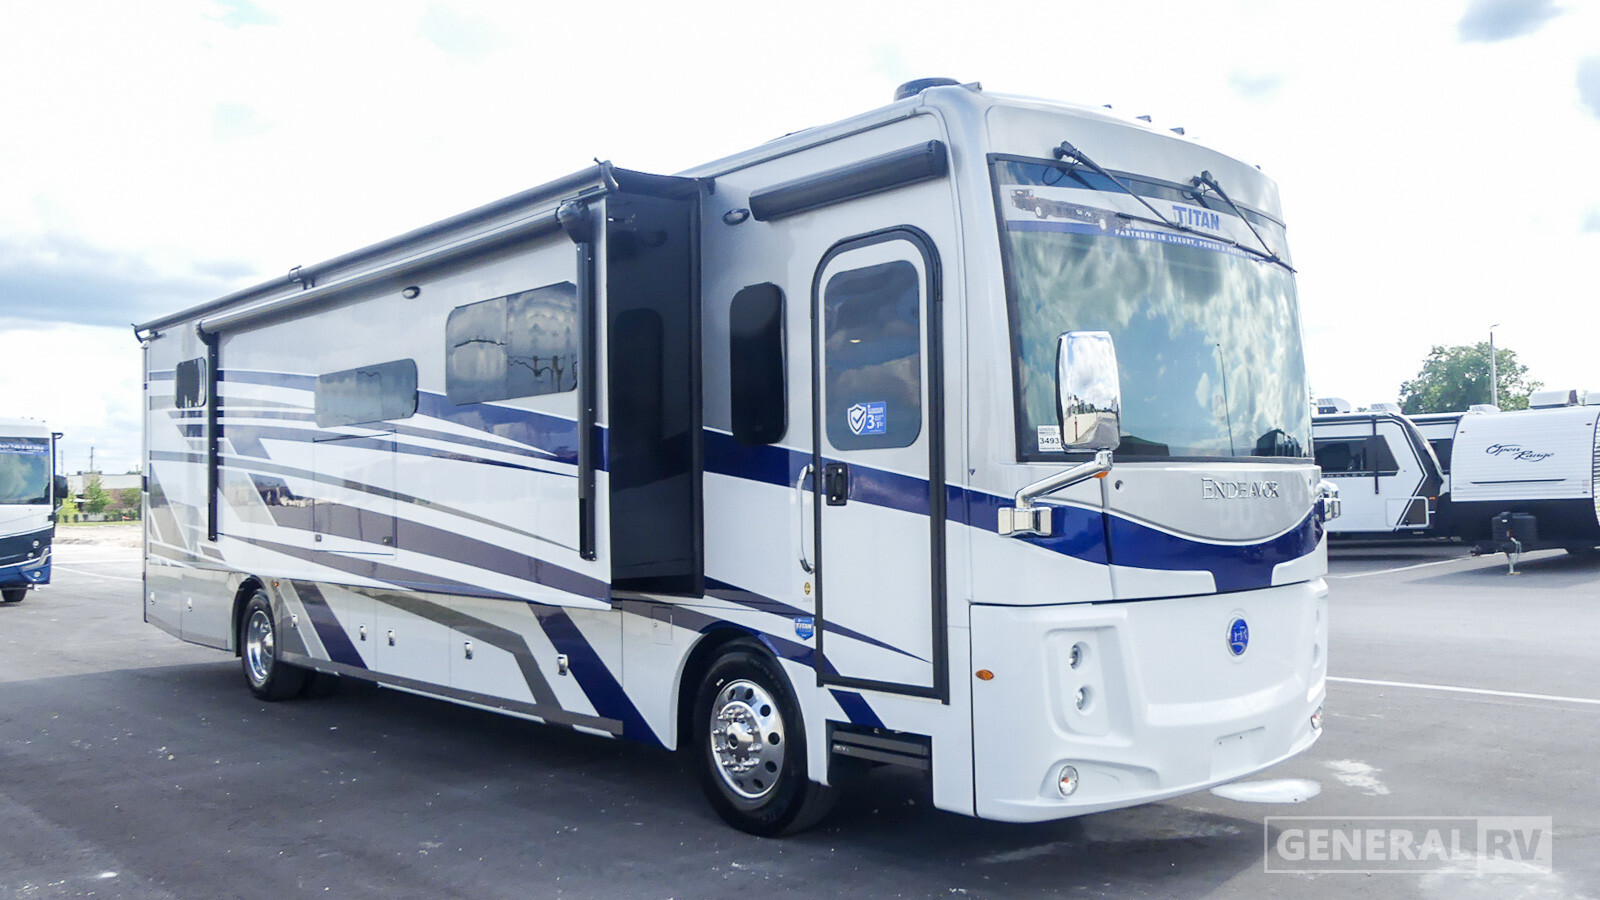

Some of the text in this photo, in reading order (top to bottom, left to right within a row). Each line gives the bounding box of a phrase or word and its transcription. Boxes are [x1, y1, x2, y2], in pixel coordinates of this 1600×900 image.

[1172, 205, 1219, 230] TITAN
[1114, 229, 1155, 240] PARTNERS
[1157, 233, 1166, 241] IN
[1168, 235, 1198, 247] LUXURY,
[1199, 240, 1220, 250] POWER
[1486, 444, 1521, 456] Open
[1513, 451, 1552, 462] Range
